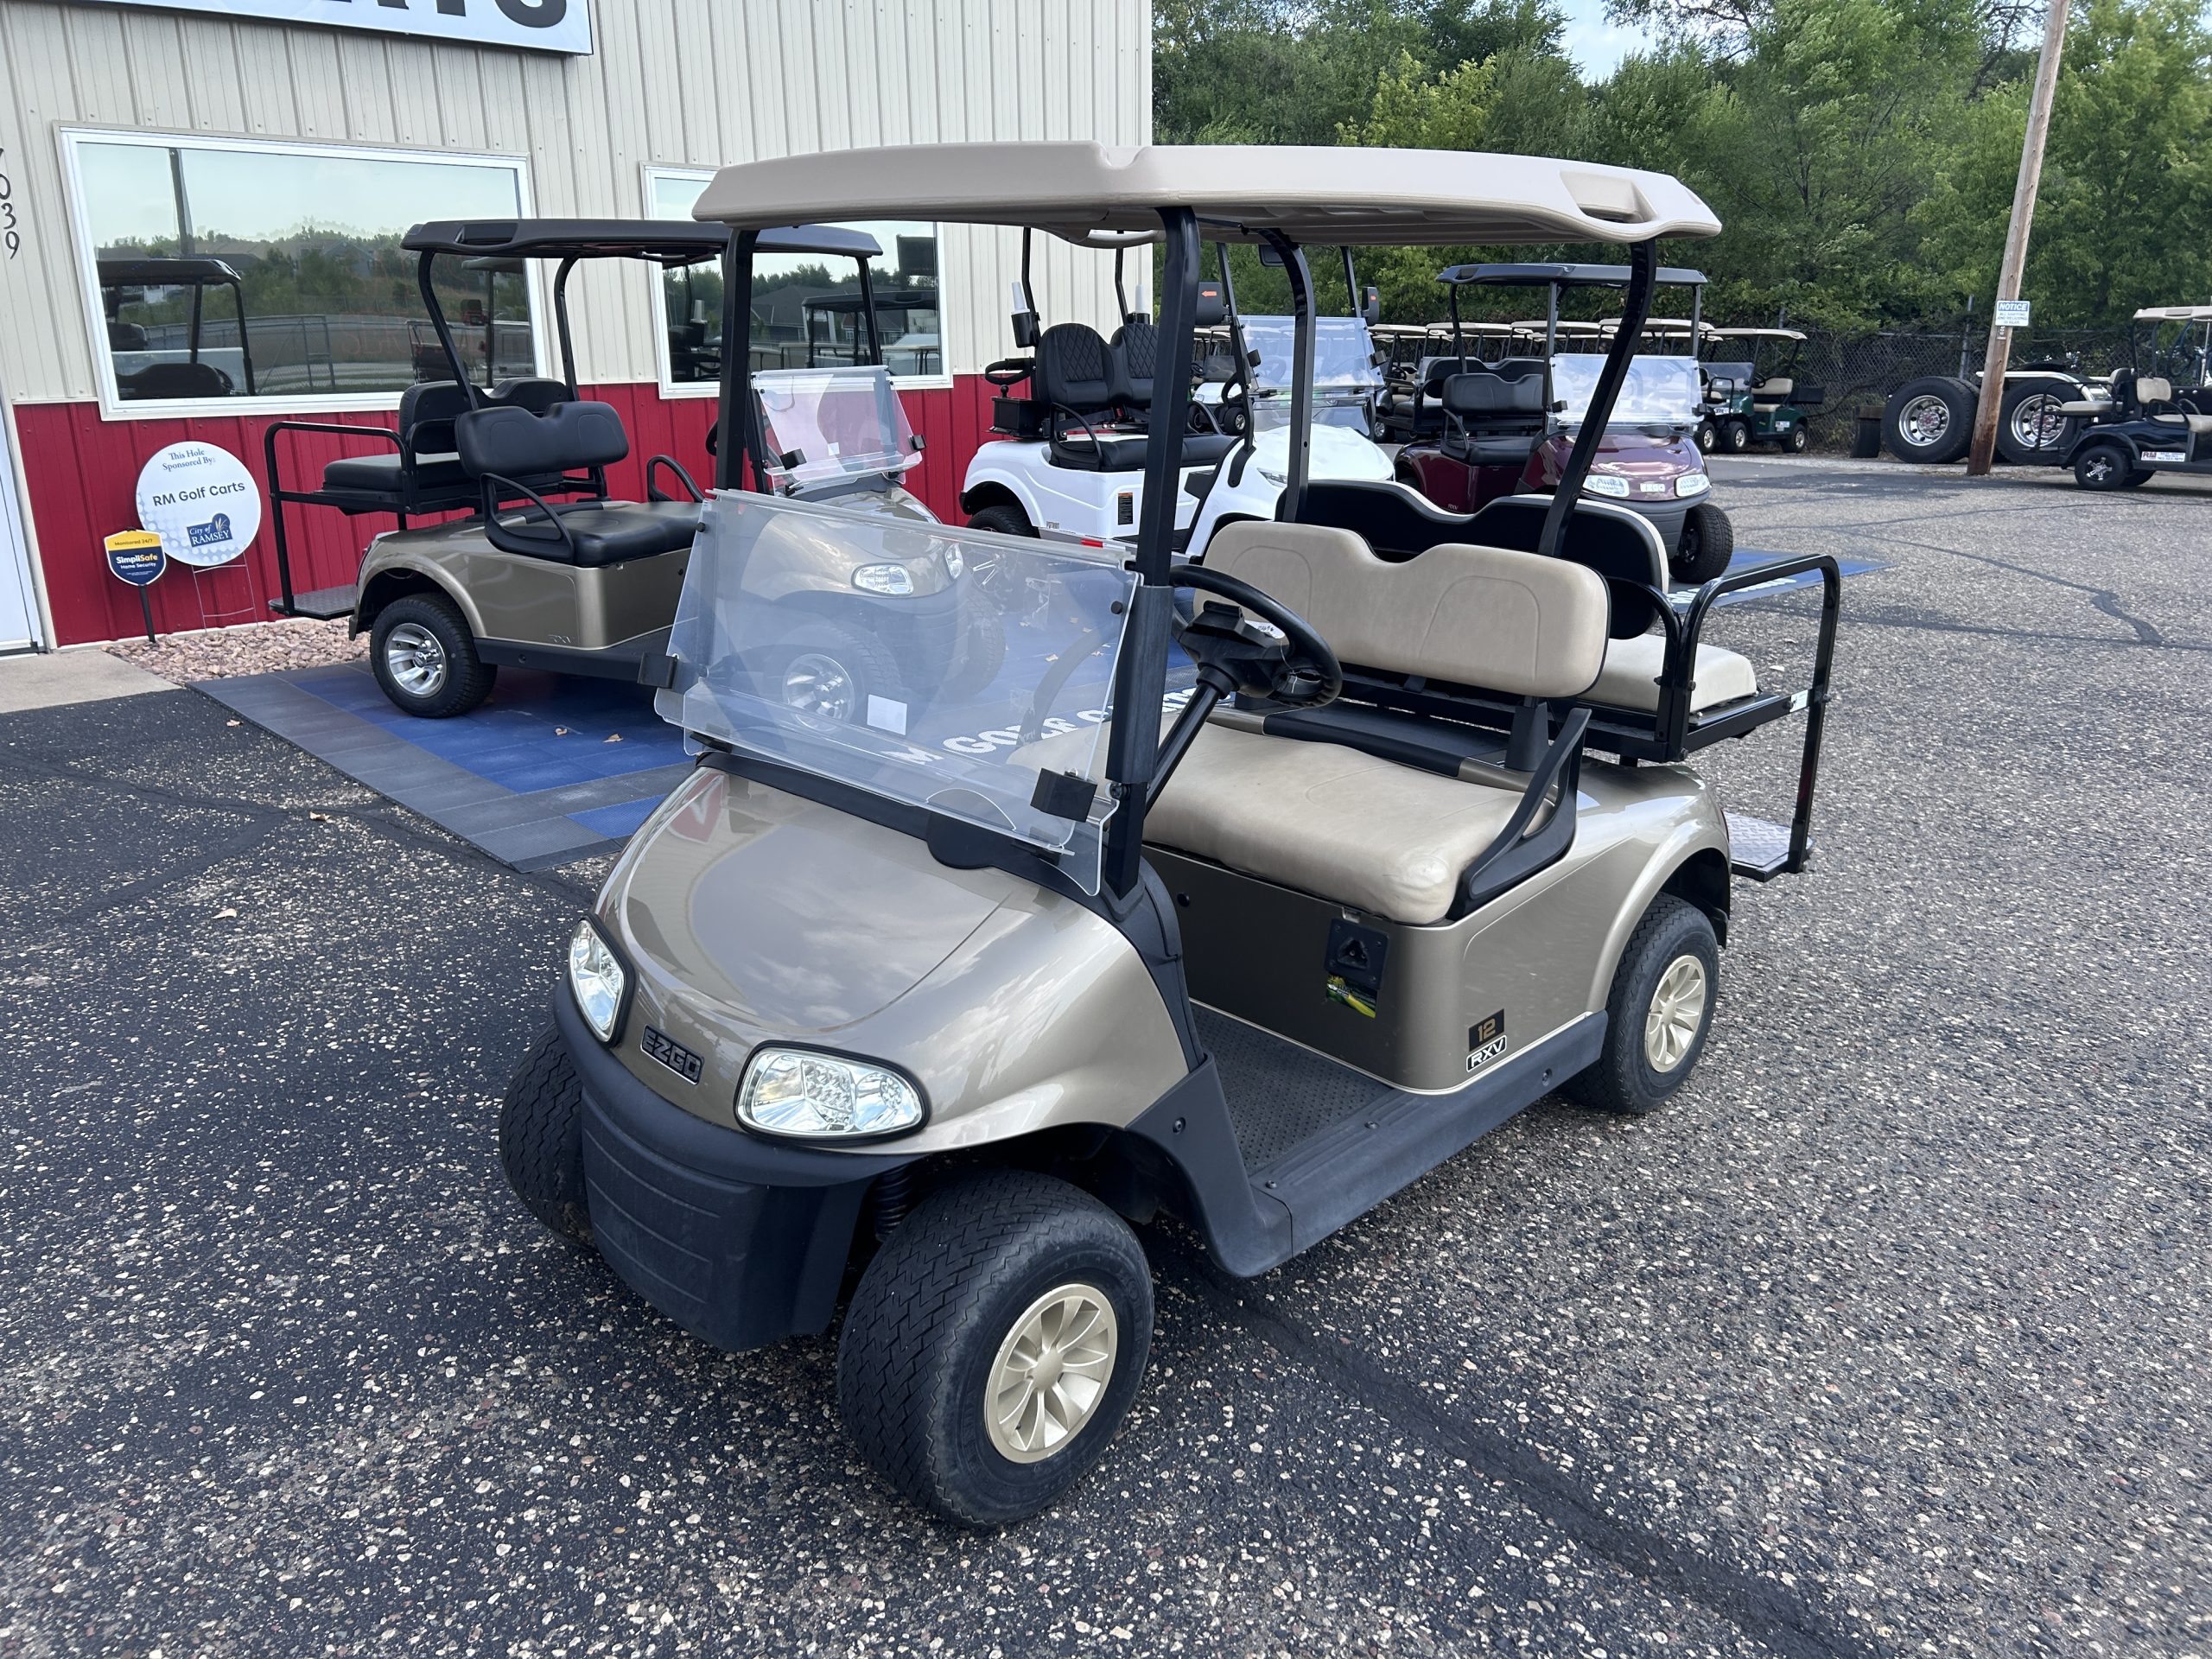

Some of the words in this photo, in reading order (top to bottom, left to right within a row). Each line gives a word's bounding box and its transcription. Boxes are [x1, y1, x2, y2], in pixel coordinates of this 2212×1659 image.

[0, 148, 20, 259] 039
[162, 457, 202, 472] Sponsored
[202, 456, 216, 466] By:
[168, 452, 186, 461] This
[186, 448, 205, 458] Hole
[153, 493, 176, 506] RM
[179, 486, 206, 501] Golf
[209, 482, 245, 496] Carts
[189, 527, 203, 536] City
[205, 524, 212, 533] of
[192, 530, 229, 544] RAMSEY
[116, 553, 158, 564] SimpliSafe
[1478, 1018, 1496, 1043] 12
[642, 1028, 702, 1081] EZGO
[1471, 1038, 1503, 1068] RXV
